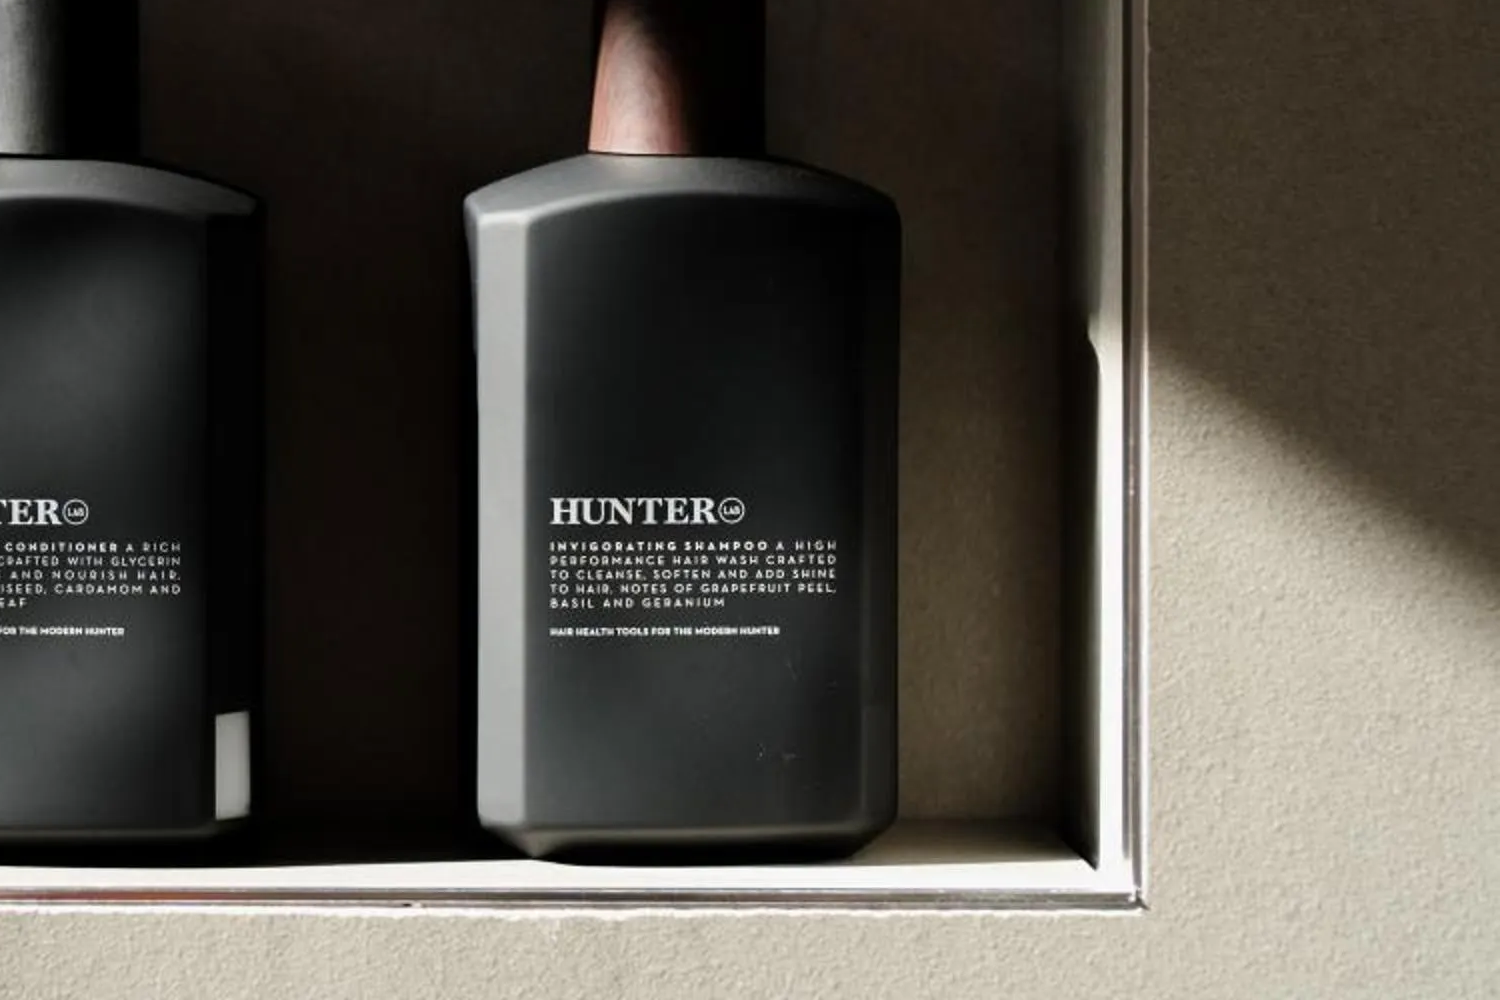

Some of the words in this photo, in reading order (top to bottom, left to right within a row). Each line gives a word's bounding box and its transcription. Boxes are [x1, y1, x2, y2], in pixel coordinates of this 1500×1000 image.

[550, 498, 717, 524] HUNTER
[4, 542, 117, 552] CONDITIONER
[126, 542, 134, 552] A
[142, 542, 181, 552] RICH
[549, 541, 676, 551] INVIGORATING
[684, 541, 768, 551] SHAMPOO
[775, 541, 785, 551] A
[795, 541, 837, 551] HIGH
[68, 556, 103, 566] WITH
[111, 556, 181, 566] GLYCERIN
[550, 555, 665, 566] PERFORMANCE
[672, 555, 708, 566] HAIR
[716, 555, 758, 566] WASH
[766, 555, 837, 566] CRAFTED
[10, 570, 43, 580] AND
[52, 570, 128, 580] NOURISH
[550, 569, 569, 580] TO
[653, 569, 710, 580] SOFTEN
[718, 569, 749, 580] AND
[755, 569, 785, 580] ADD
[792, 569, 837, 580] SHINE
[54, 584, 142, 595] CARDAMOM
[150, 584, 181, 595] AND
[550, 584, 569, 594] TO
[620, 584, 667, 594] NOTES
[674, 584, 693, 594] OF
[700, 584, 790, 594] GRAPEFRUIT
[550, 598, 594, 608] BASIL
[603, 598, 634, 608] AND
[642, 598, 724, 608] GERANIUM
[19, 626, 38, 636] THE
[40, 626, 83, 636] MODERN
[86, 626, 124, 636] HUNTER
[550, 627, 573, 636] HAIR
[576, 627, 614, 636] HEALTH
[616, 627, 649, 636] TOOLS
[652, 627, 671, 636] FOR
[674, 627, 692, 636] THE
[695, 627, 738, 636] MODERN
[740, 627, 780, 636] HUNTER
